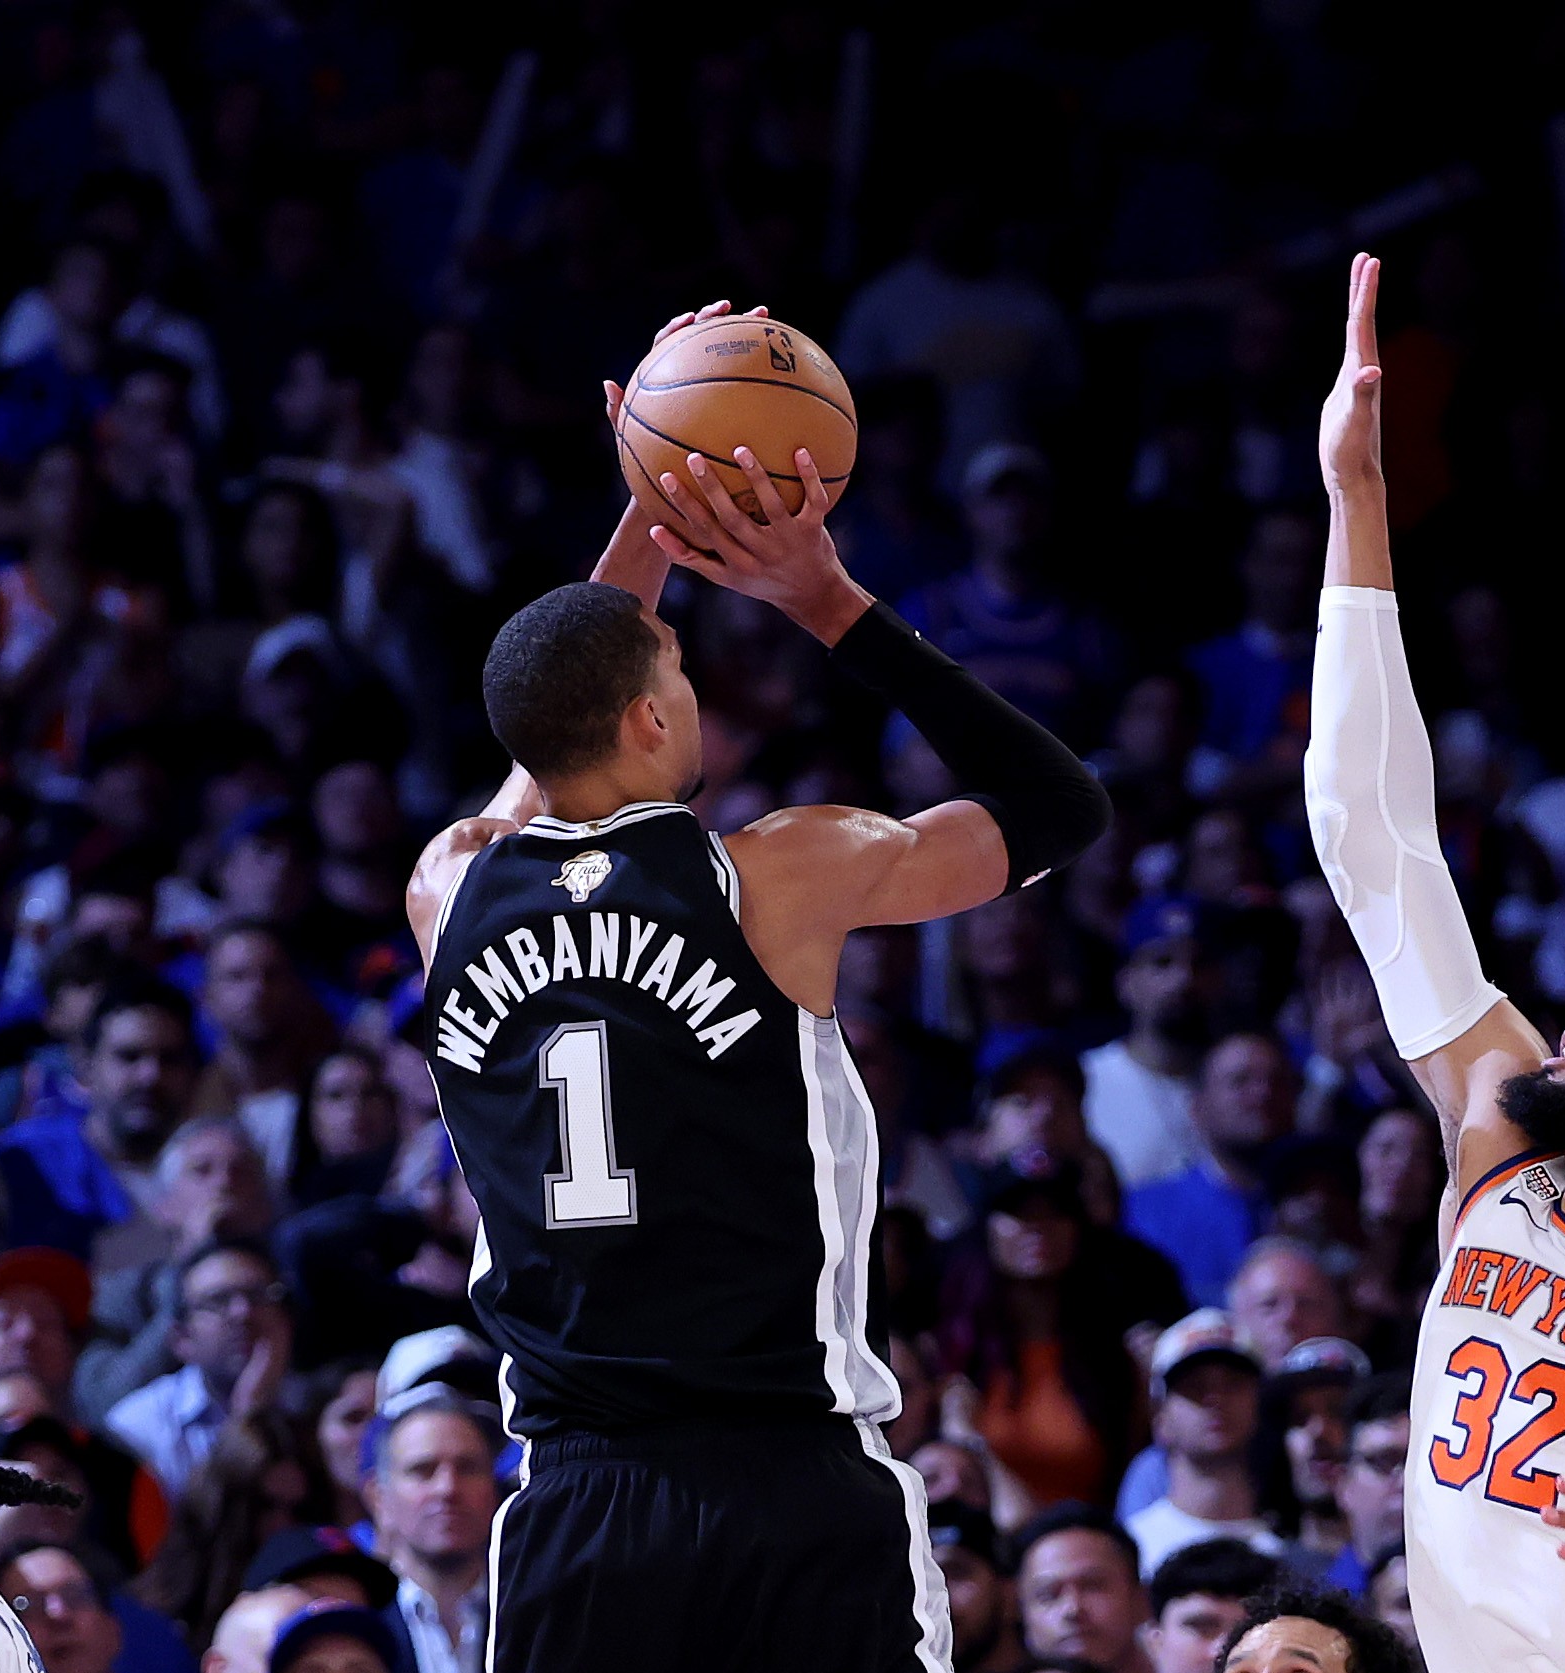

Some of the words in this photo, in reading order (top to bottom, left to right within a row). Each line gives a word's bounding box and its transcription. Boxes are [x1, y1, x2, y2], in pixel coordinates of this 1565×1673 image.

[437, 912, 762, 1074] WEMBANYAMA
[538, 1019, 638, 1230] 1
[1535, 1167, 1555, 1195] USA
[1439, 1247, 1547, 1320] NEW
